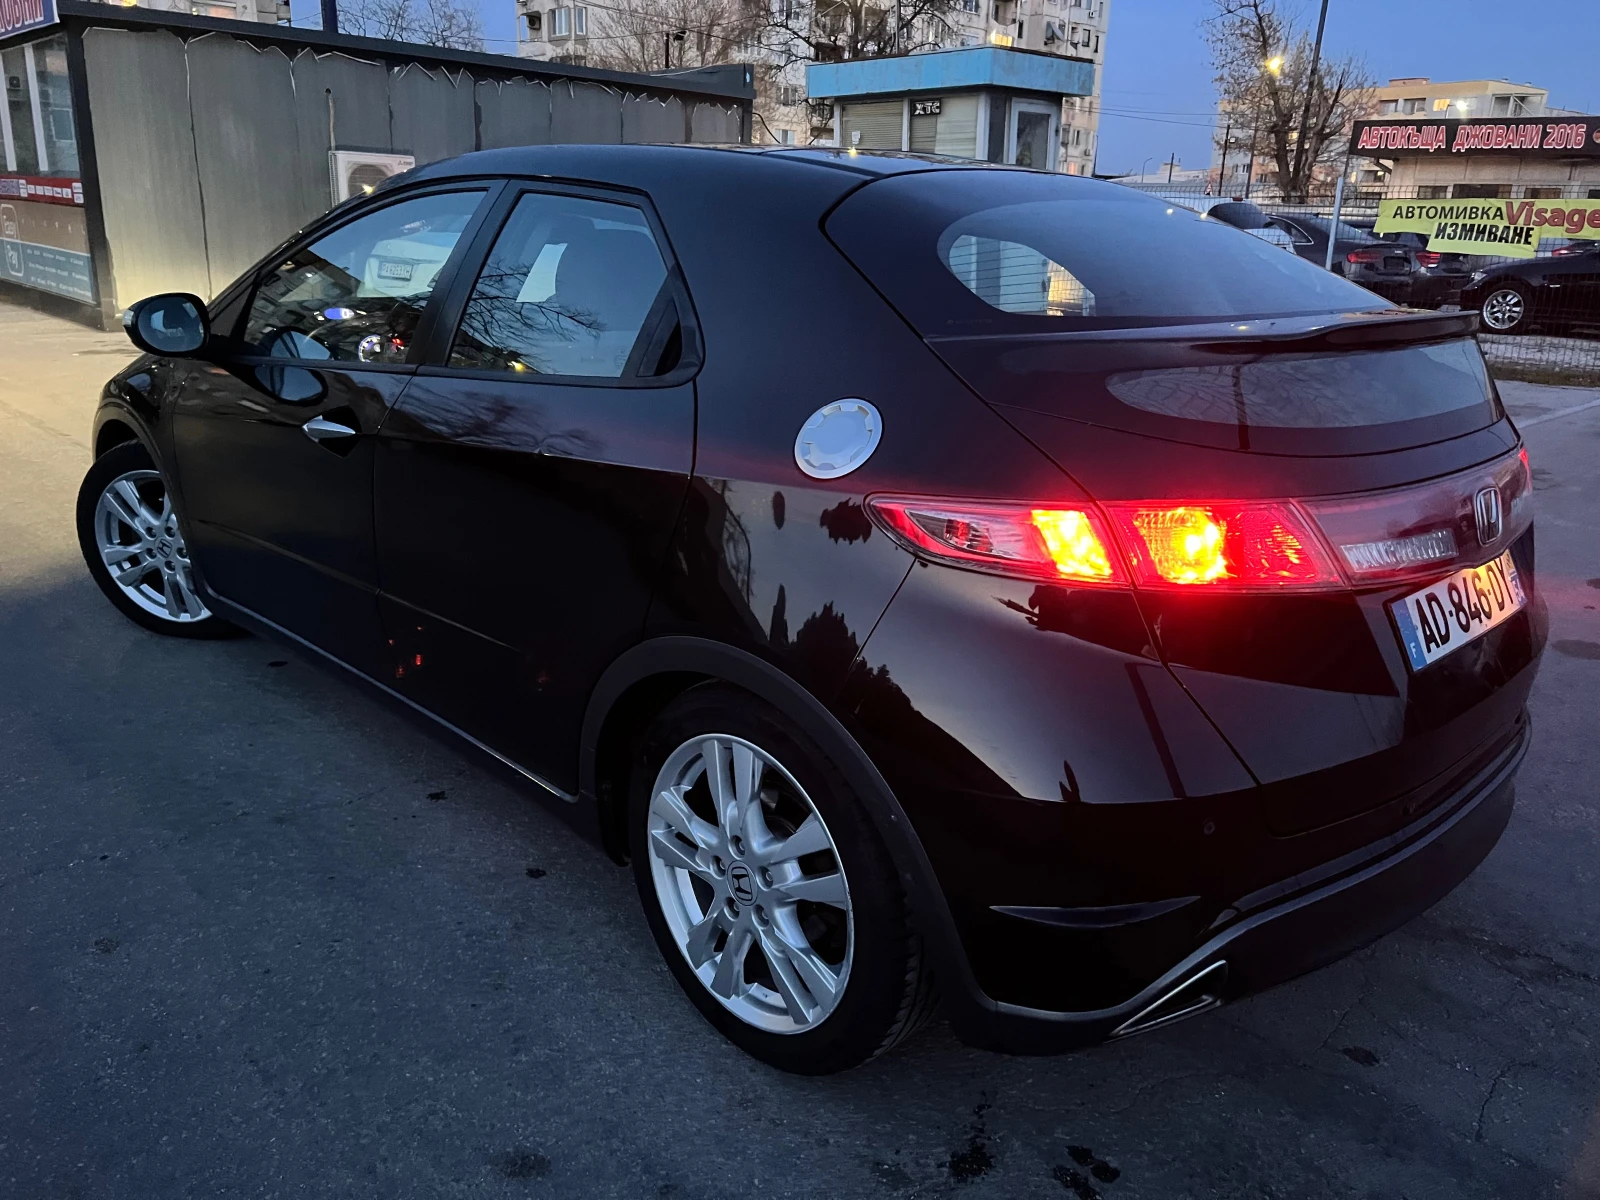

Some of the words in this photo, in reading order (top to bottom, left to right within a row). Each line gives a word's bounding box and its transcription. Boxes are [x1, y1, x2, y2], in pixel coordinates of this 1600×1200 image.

[1358, 126, 1446, 152] АВТОКЪЩА
[1452, 124, 1542, 152] ДЖОВАНИ
[1543, 123, 1587, 148] 2016
[1392, 206, 1505, 221] АВТОМИВКА
[1505, 201, 1600, 234] Visage
[1434, 222, 1535, 245] ИЗМИВАНЕ
[1415, 557, 1514, 654] AD-846-DY
[1409, 642, 1418, 658] F
